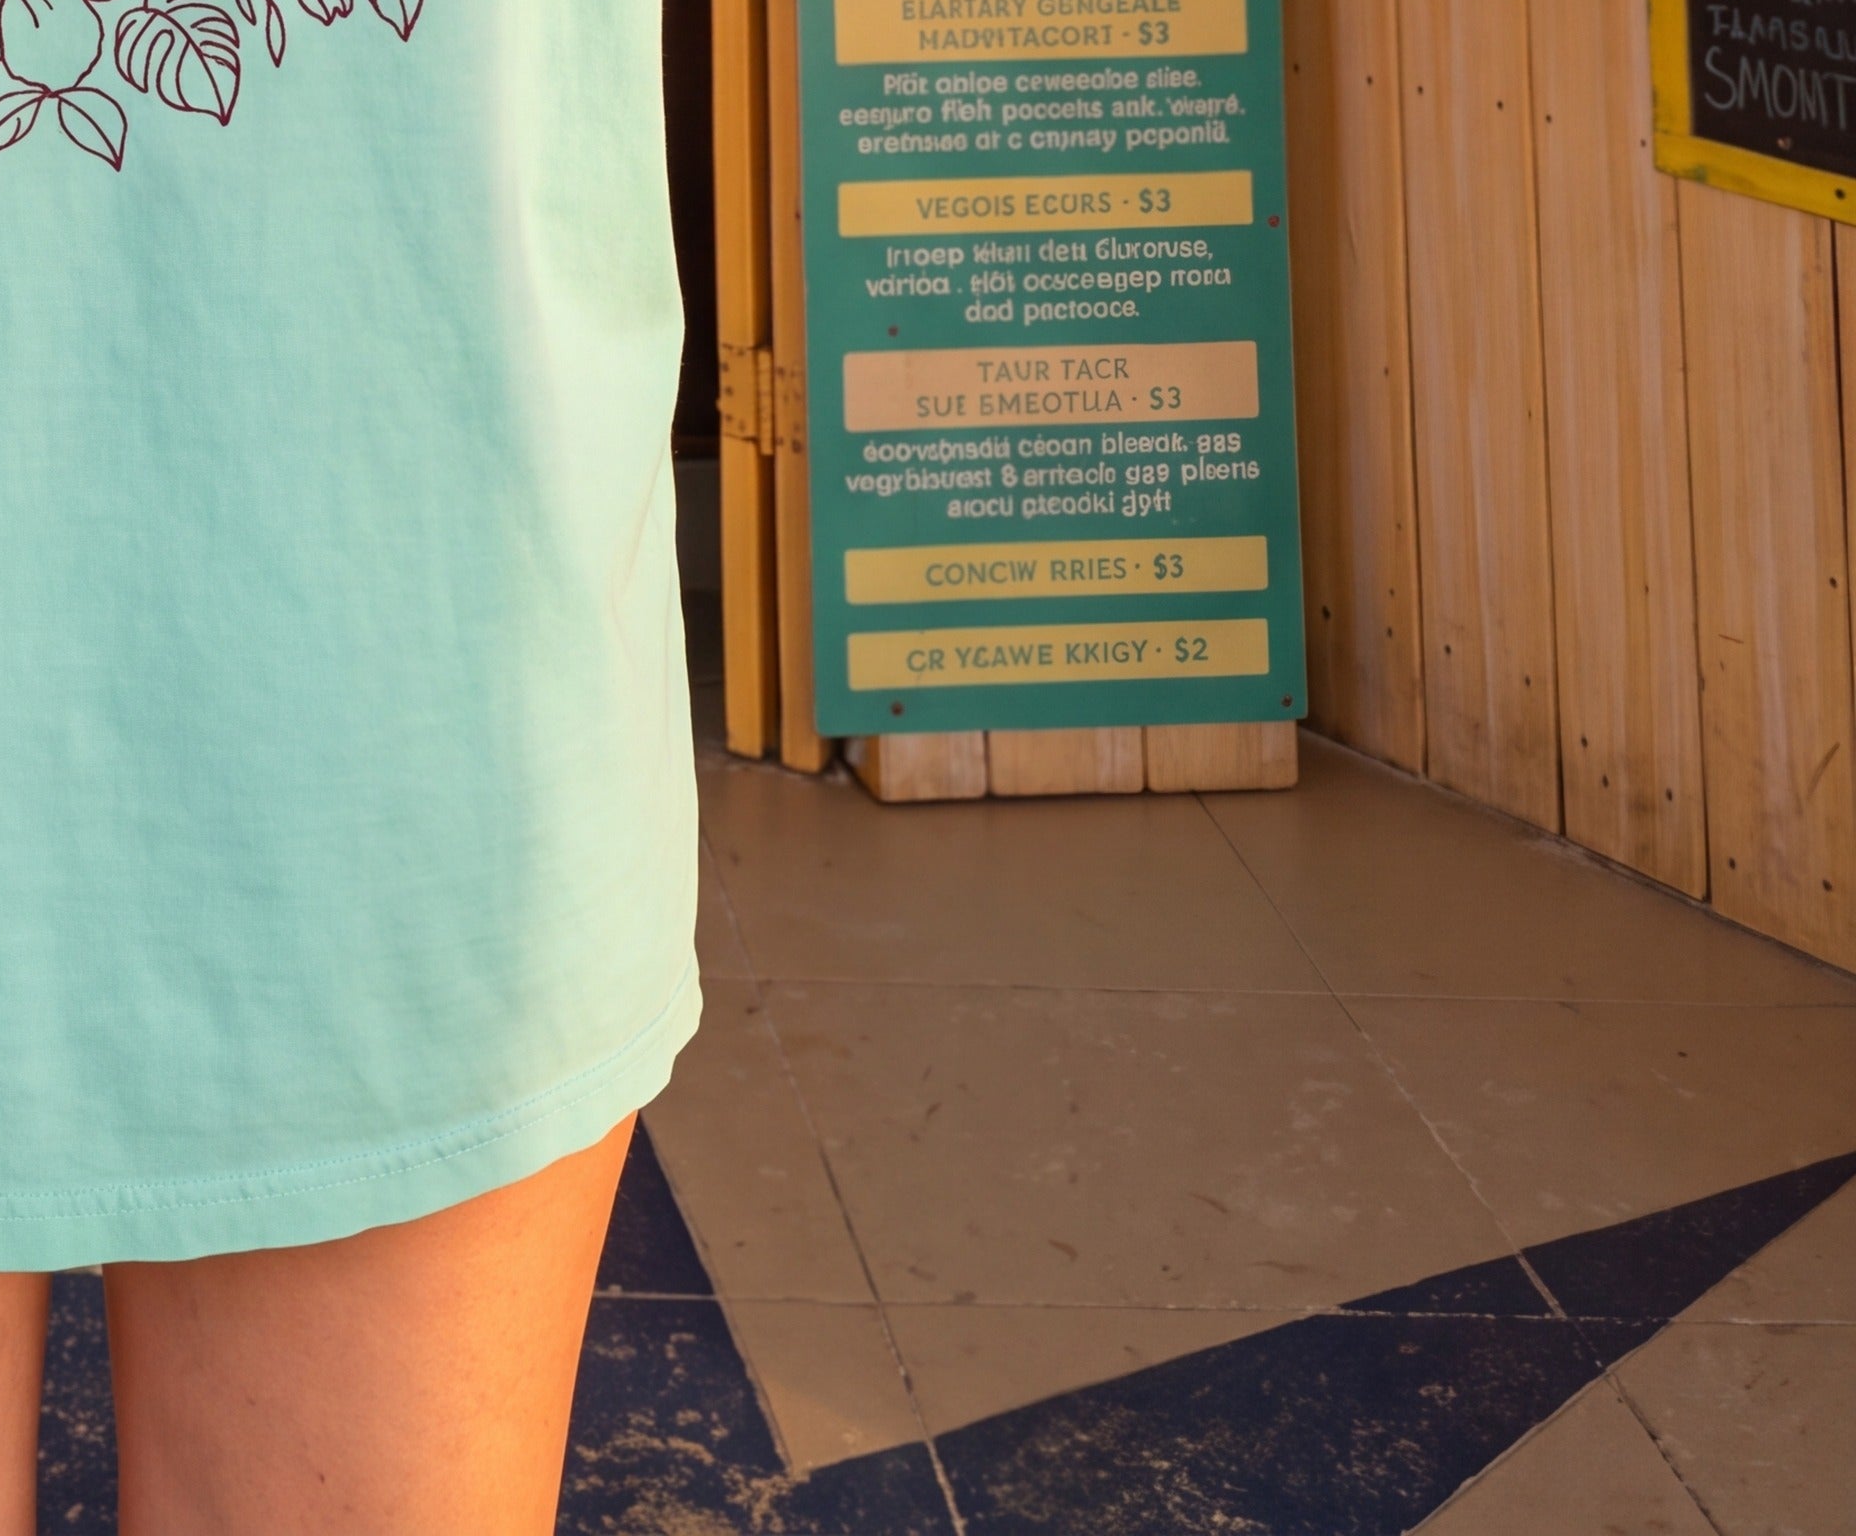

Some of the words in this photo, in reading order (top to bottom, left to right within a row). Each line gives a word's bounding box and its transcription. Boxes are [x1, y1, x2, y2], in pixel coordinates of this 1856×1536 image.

[1138, 20, 1171, 46] $3
[917, 194, 1016, 219] VEGOIS
[1138, 188, 1172, 214] $3
[1050, 557, 1127, 582] RRIES
[1153, 553, 1185, 580] $3
[1174, 637, 1209, 662] $2
